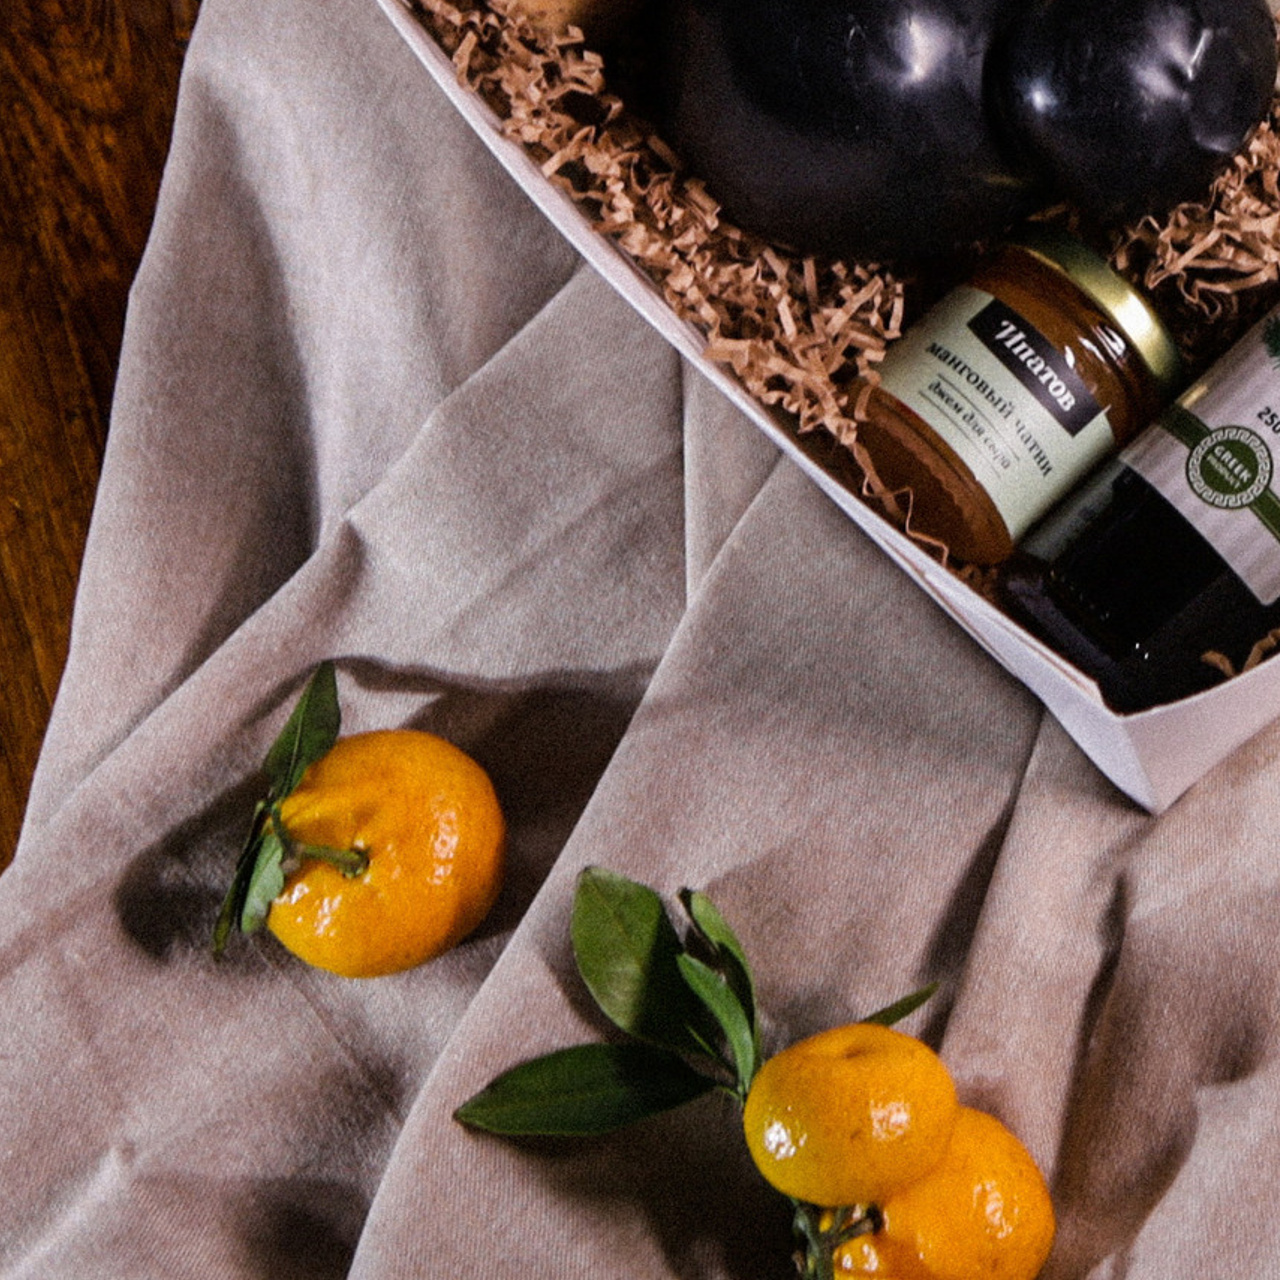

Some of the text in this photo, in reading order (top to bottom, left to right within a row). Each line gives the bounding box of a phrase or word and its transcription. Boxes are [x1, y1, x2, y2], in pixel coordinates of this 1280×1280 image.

[927, 342, 1053, 478] манговый чатни
[994, 319, 1077, 413] Ипатов
[1212, 445, 1252, 483] GREEK
